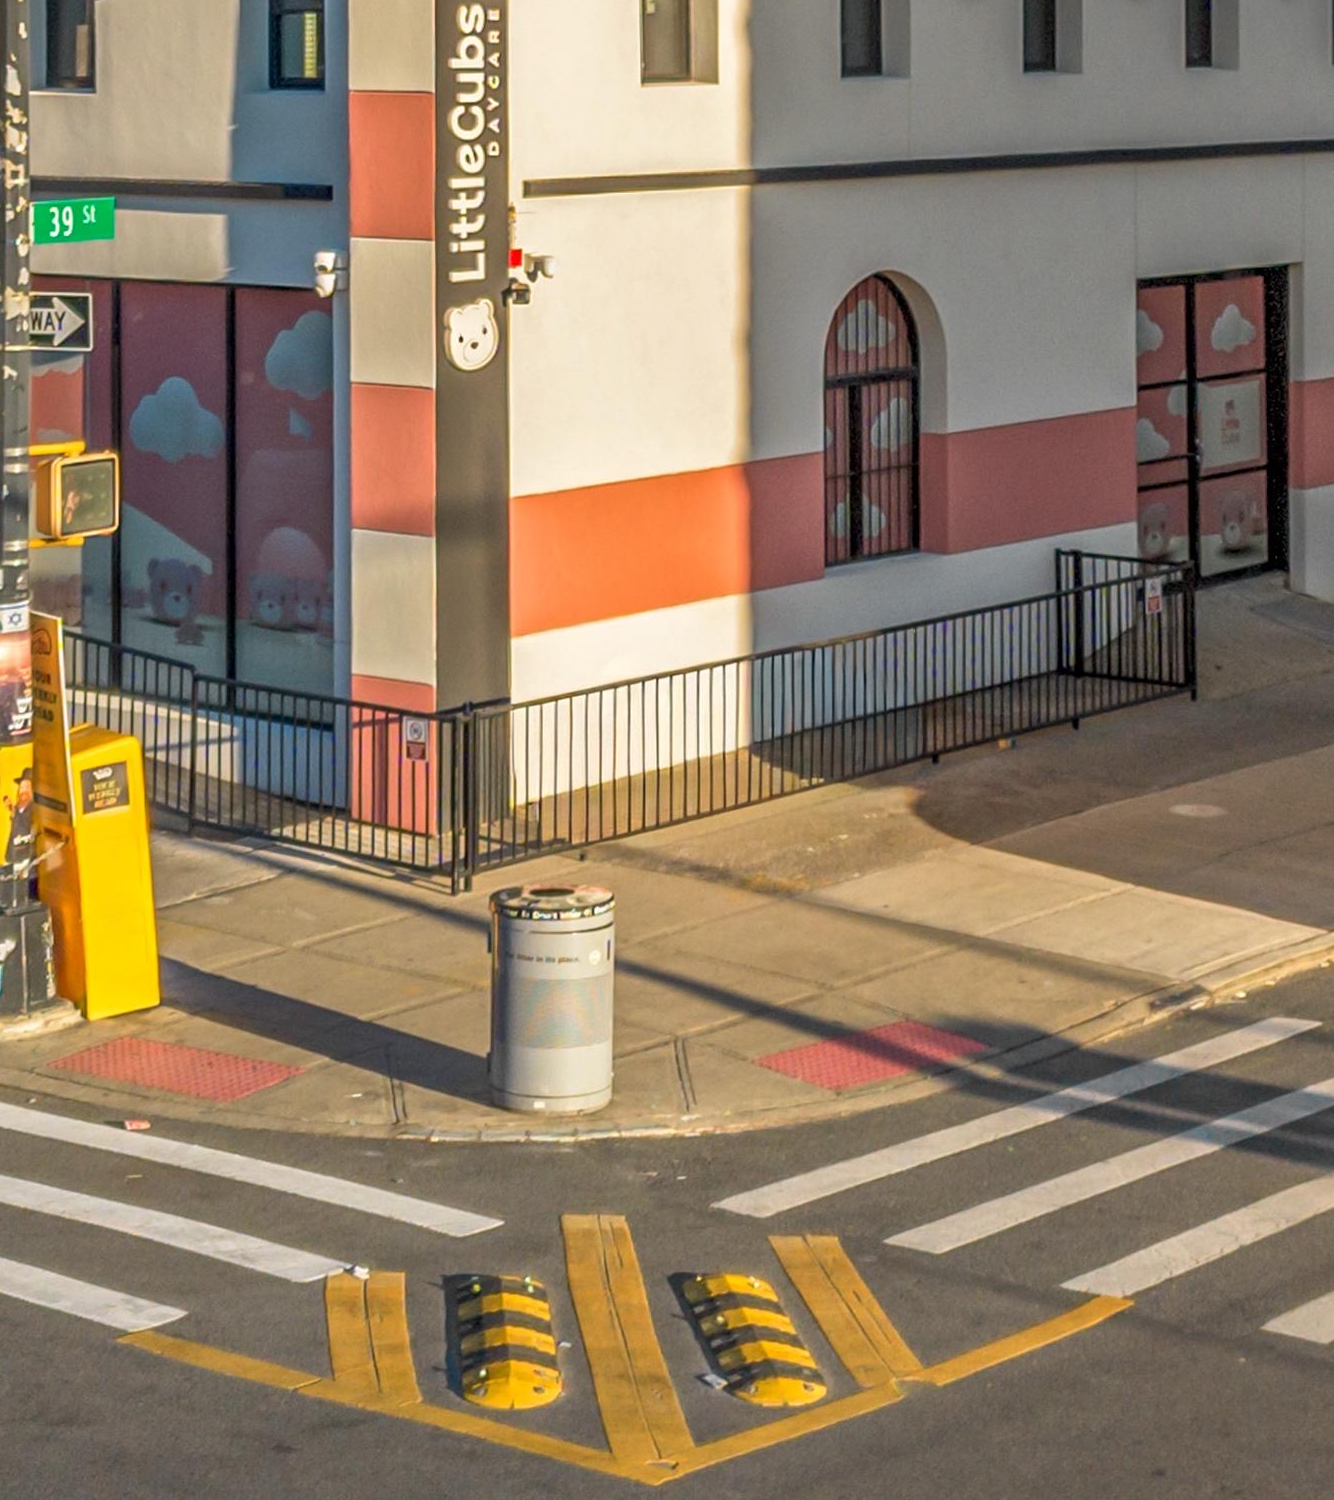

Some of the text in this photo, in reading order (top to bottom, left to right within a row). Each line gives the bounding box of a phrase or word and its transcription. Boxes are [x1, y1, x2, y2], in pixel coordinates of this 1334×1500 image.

[488, 8, 502, 157] DAYCARE
[448, 2, 486, 283] LittleCubs
[49, 205, 96, 237] 39 St
[31, 311, 67, 331] WAY
